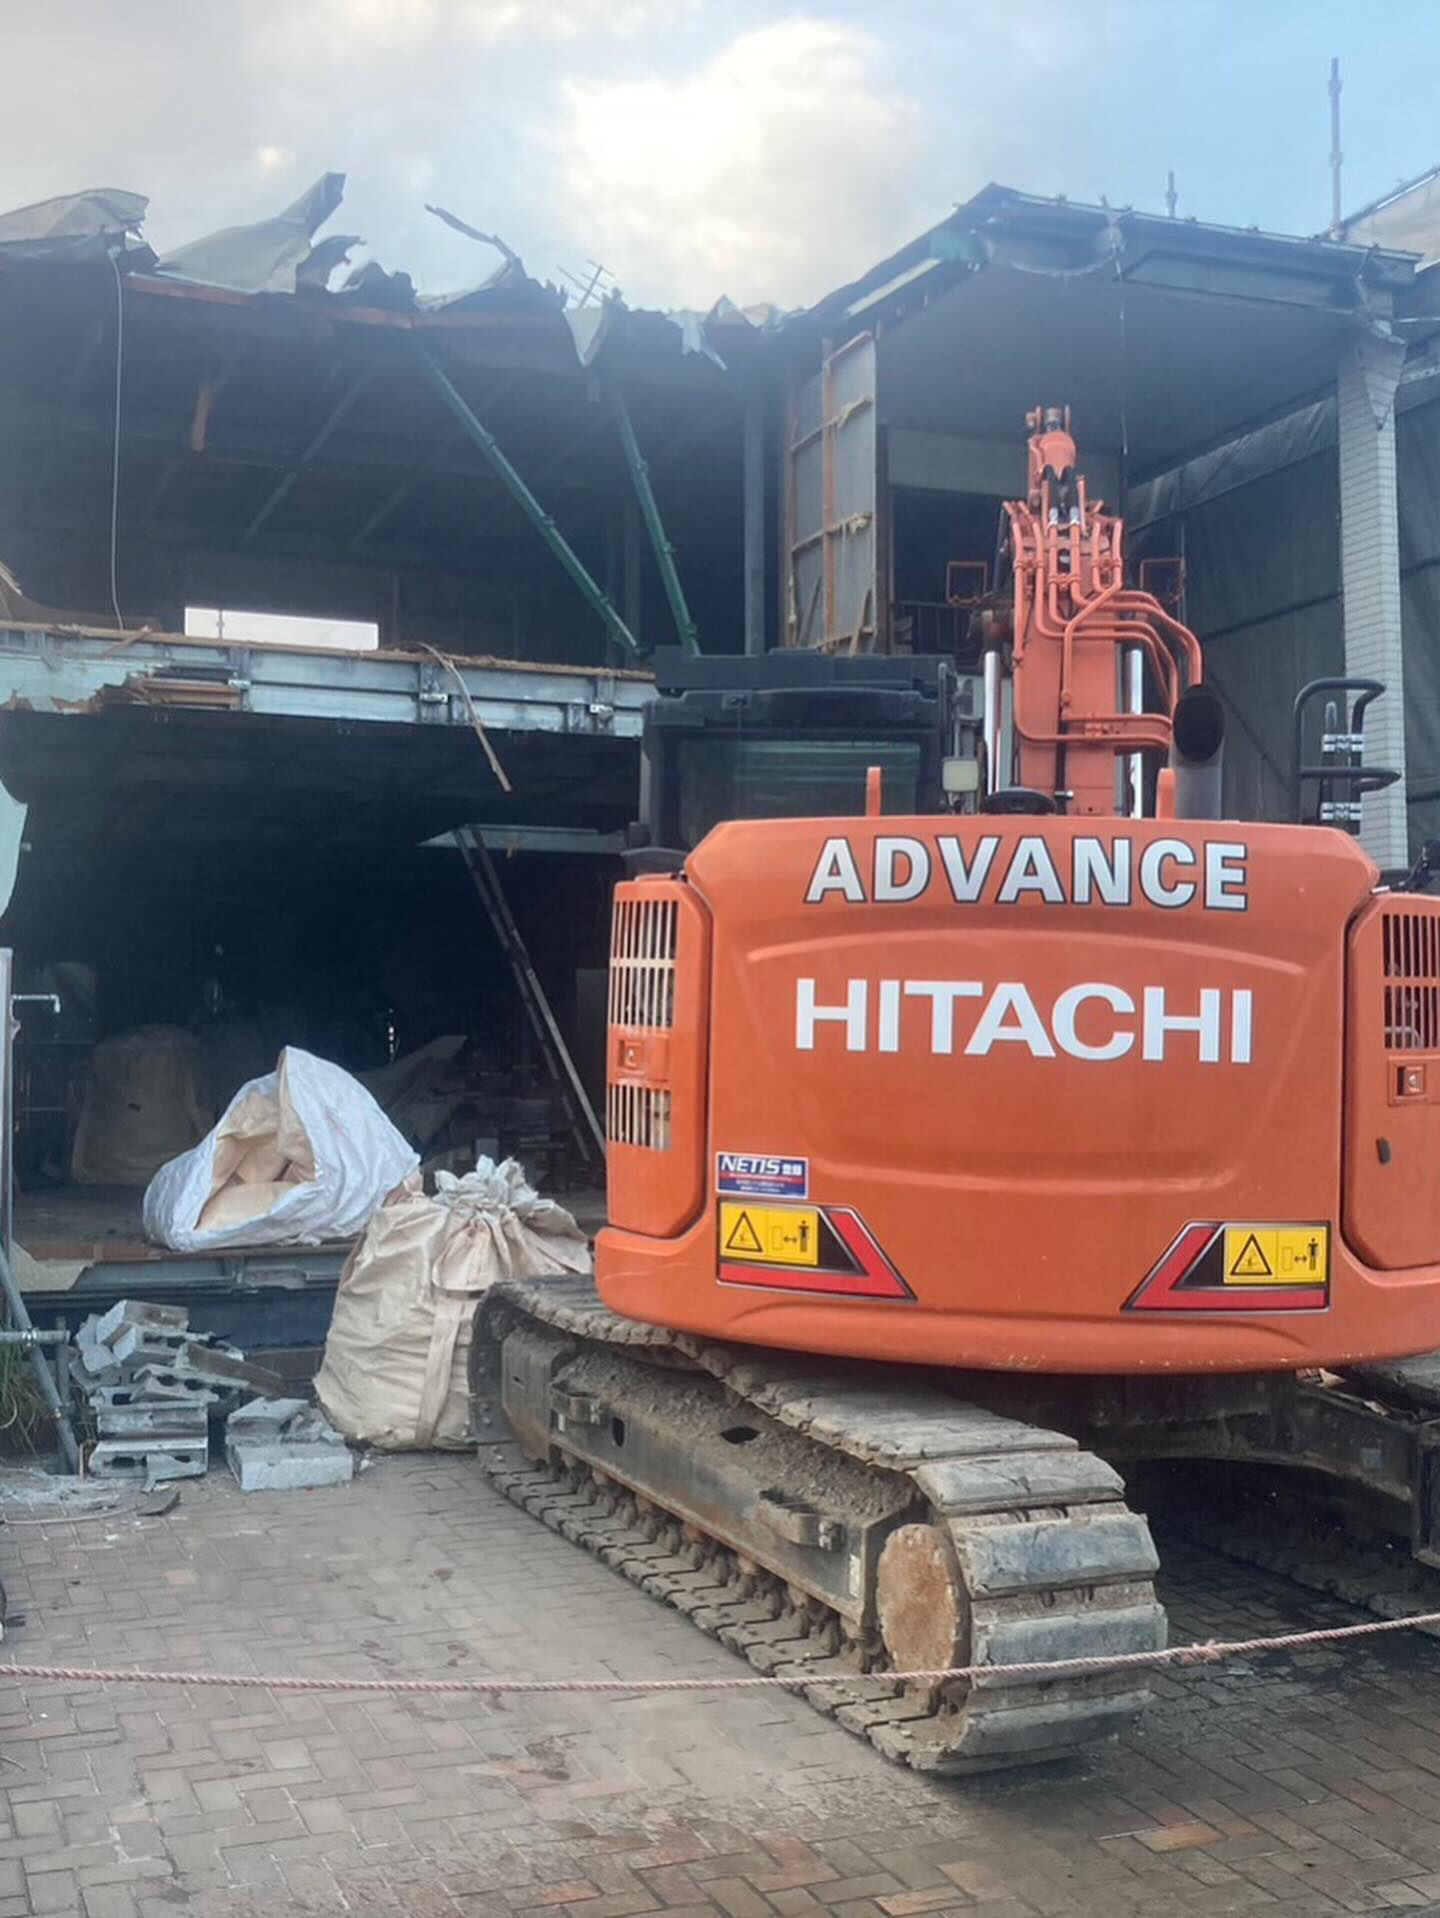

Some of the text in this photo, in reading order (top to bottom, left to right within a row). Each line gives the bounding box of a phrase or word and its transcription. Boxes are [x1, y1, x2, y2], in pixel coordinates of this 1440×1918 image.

[804, 835, 1248, 911] ADVANCE
[796, 977, 1252, 1063] HITACHI
[721, 1155, 781, 1174] NETIS
